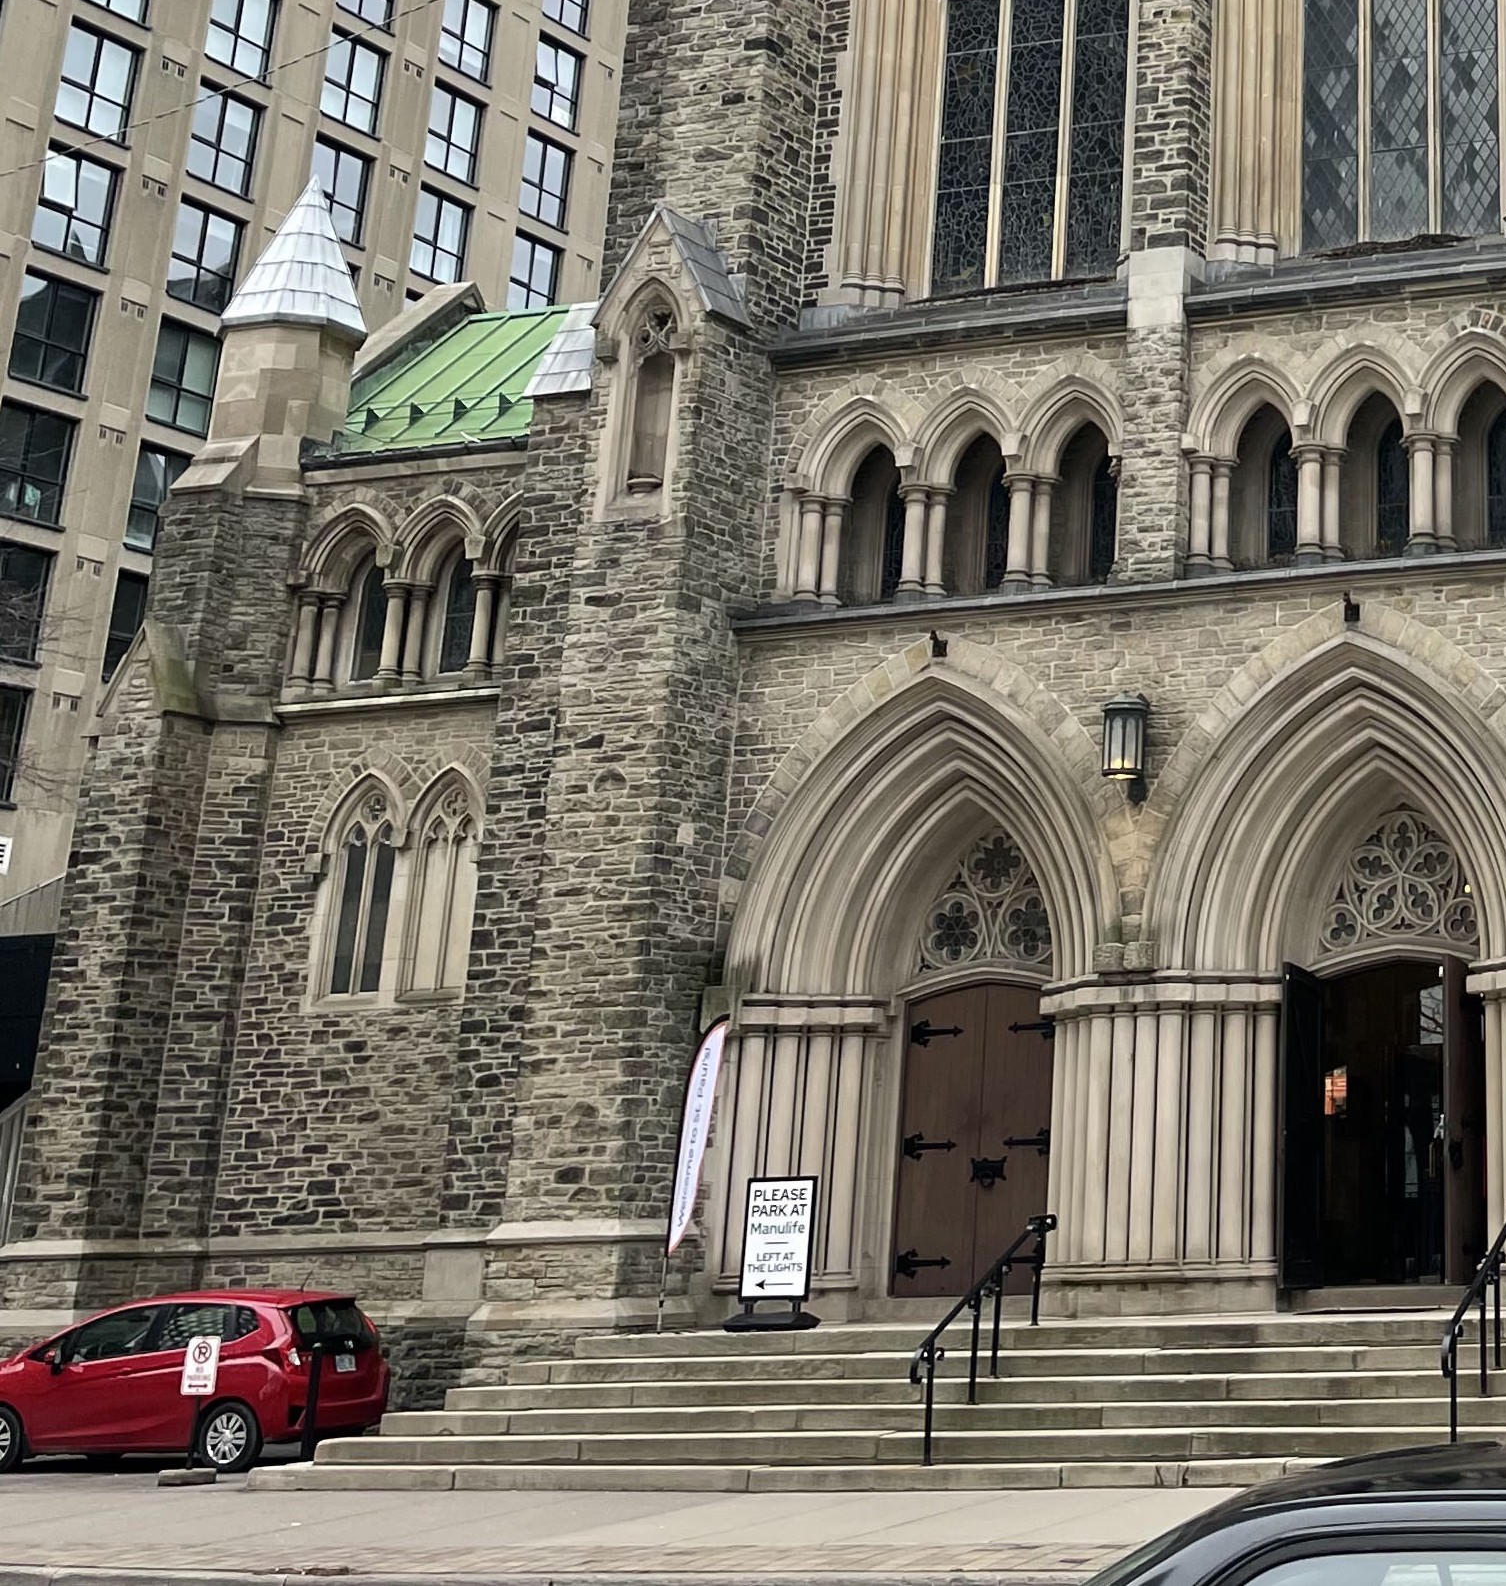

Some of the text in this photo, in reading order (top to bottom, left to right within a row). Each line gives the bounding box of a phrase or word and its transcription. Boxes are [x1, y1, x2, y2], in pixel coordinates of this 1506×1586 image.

[677, 1148, 694, 1227] Welcome
[690, 1127, 698, 1145] to
[753, 1188, 808, 1202] PLEASE
[751, 1204, 808, 1217] PARK AT
[750, 1221, 806, 1235] Manulife
[756, 1252, 796, 1262] LEFT AT
[747, 1262, 803, 1273] THE LIGHTS
